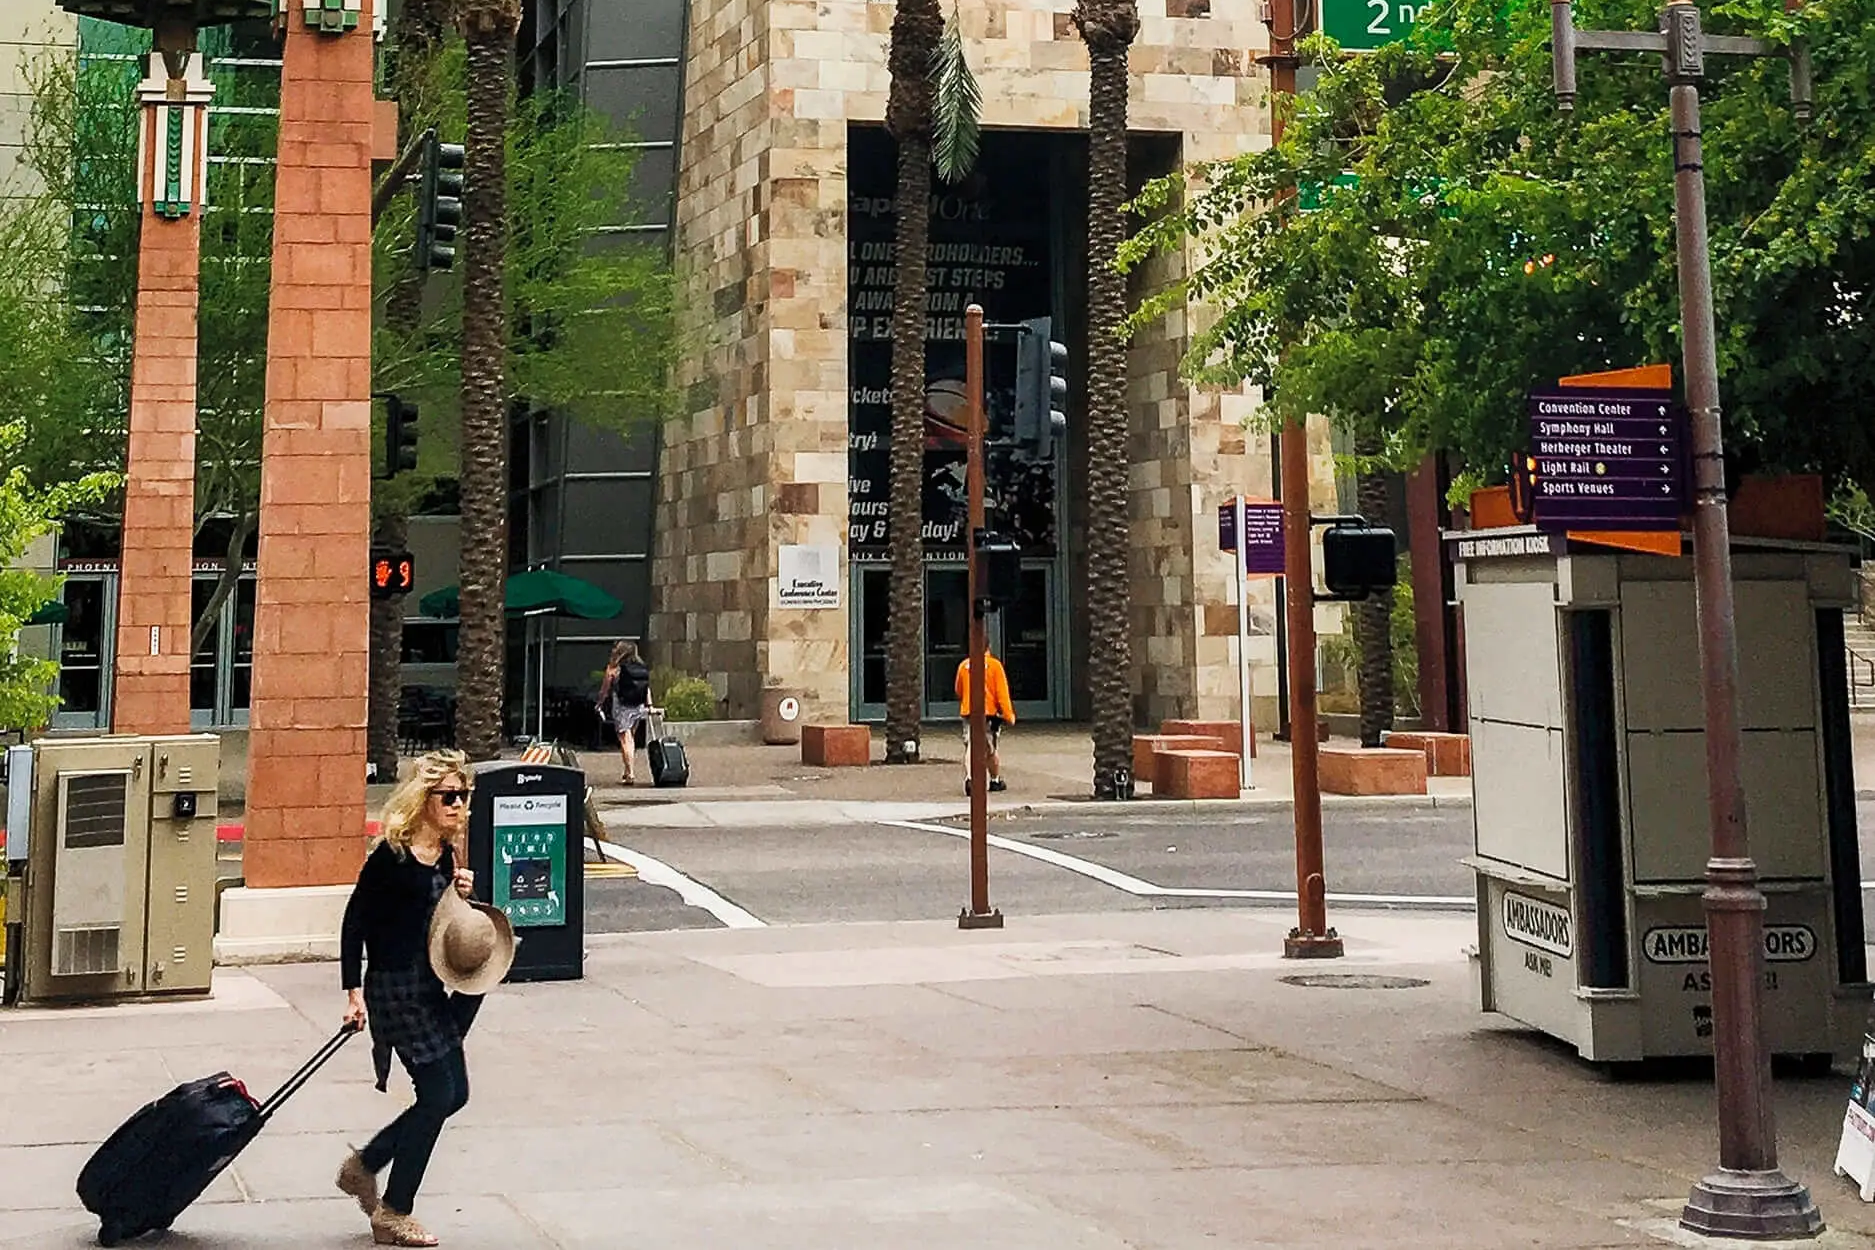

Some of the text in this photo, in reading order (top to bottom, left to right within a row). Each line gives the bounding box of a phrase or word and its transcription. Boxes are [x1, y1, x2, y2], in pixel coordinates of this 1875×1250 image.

[951, 267, 1006, 289] STEPS
[855, 291, 894, 311] AWA
[1538, 401, 1632, 415] Convention Center
[1540, 421, 1615, 437] Symphony Hall
[1541, 441, 1632, 457] Herberger Theater
[1542, 461, 1590, 477] Light Rail
[1543, 481, 1614, 496] Sports Venues
[67, 563, 117, 571] PHOENI
[399, 561, 410, 587] 9
[1506, 898, 1570, 949] AMBASSADORS
[1682, 971, 1711, 991] AS
